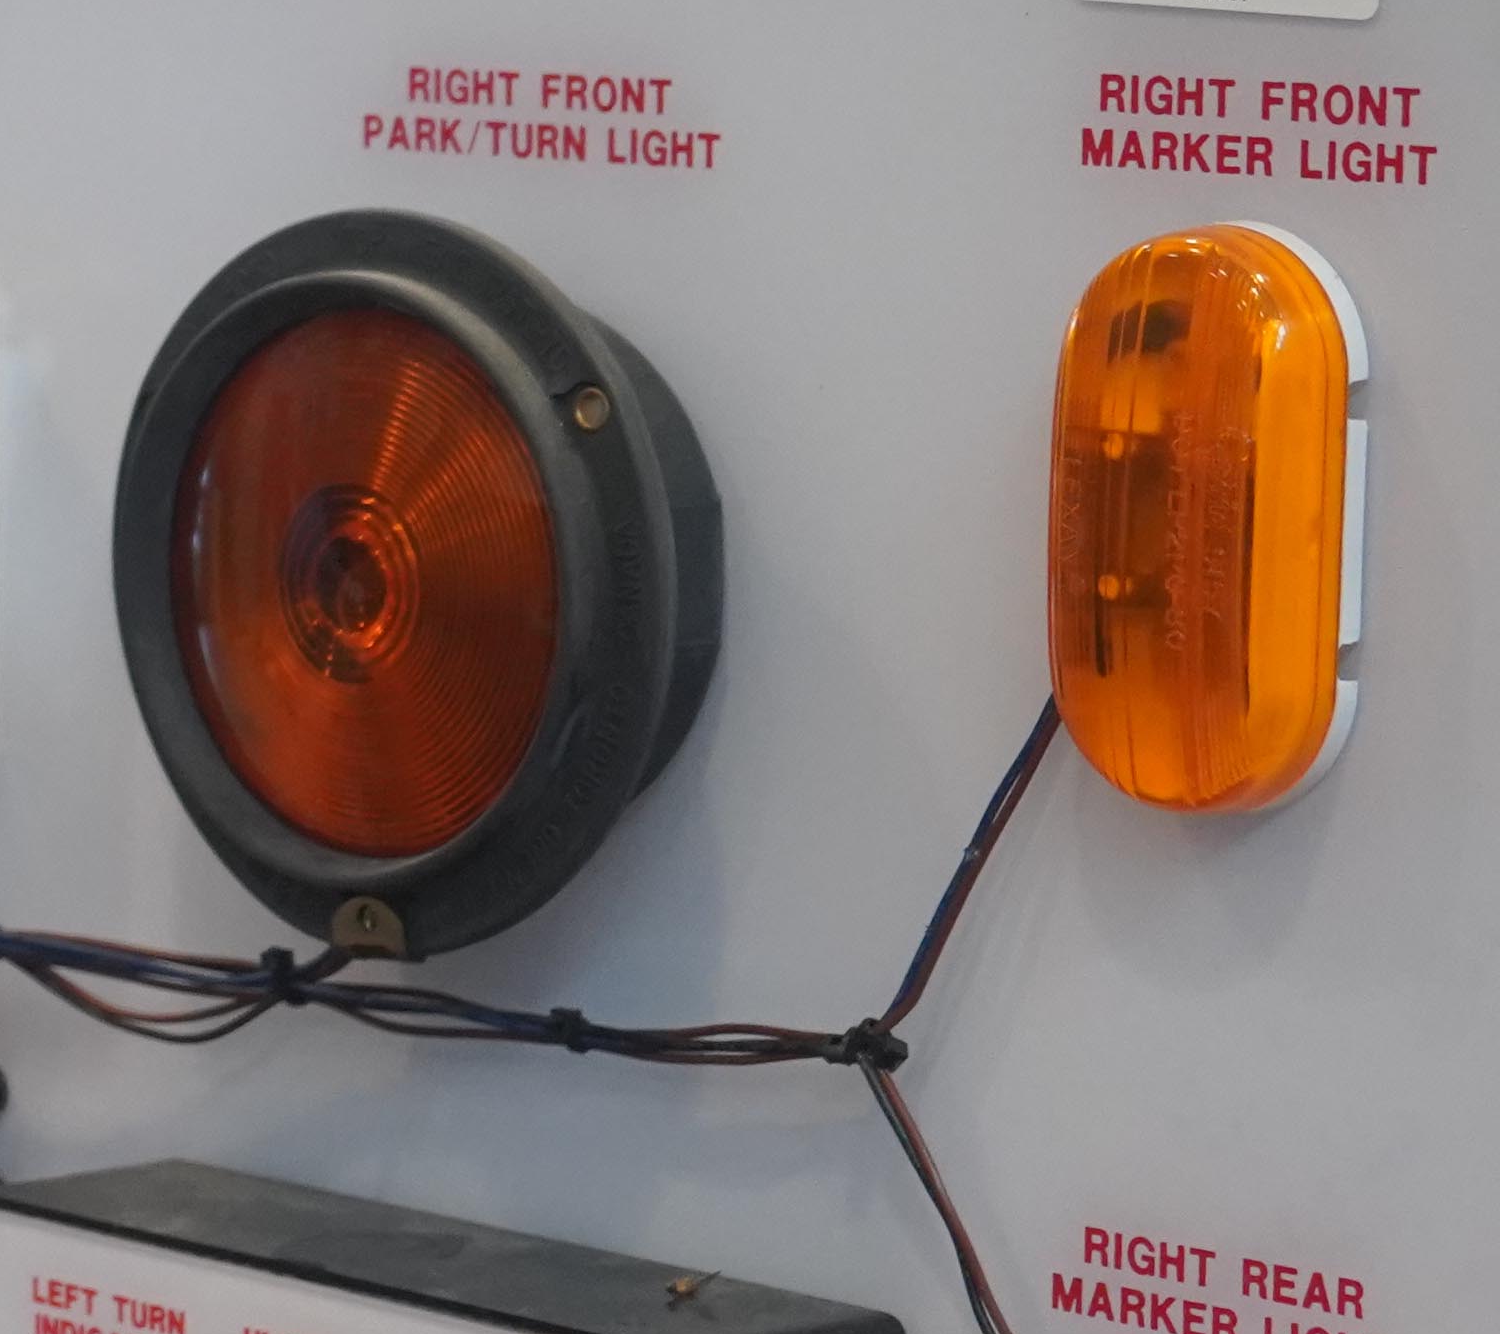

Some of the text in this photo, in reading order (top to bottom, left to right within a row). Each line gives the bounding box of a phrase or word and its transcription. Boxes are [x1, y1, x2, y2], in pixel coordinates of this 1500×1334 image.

[408, 67, 672, 114] RIGHT FRONT
[1100, 74, 1420, 127] RIGHT FRONT
[363, 114, 720, 168] PARK/TURN LIGHT
[1082, 128, 1437, 185] MARKER LIGHT
[32, 1277, 101, 1317] LEFT
[1084, 1226, 1364, 1319] RIGHT REAR
